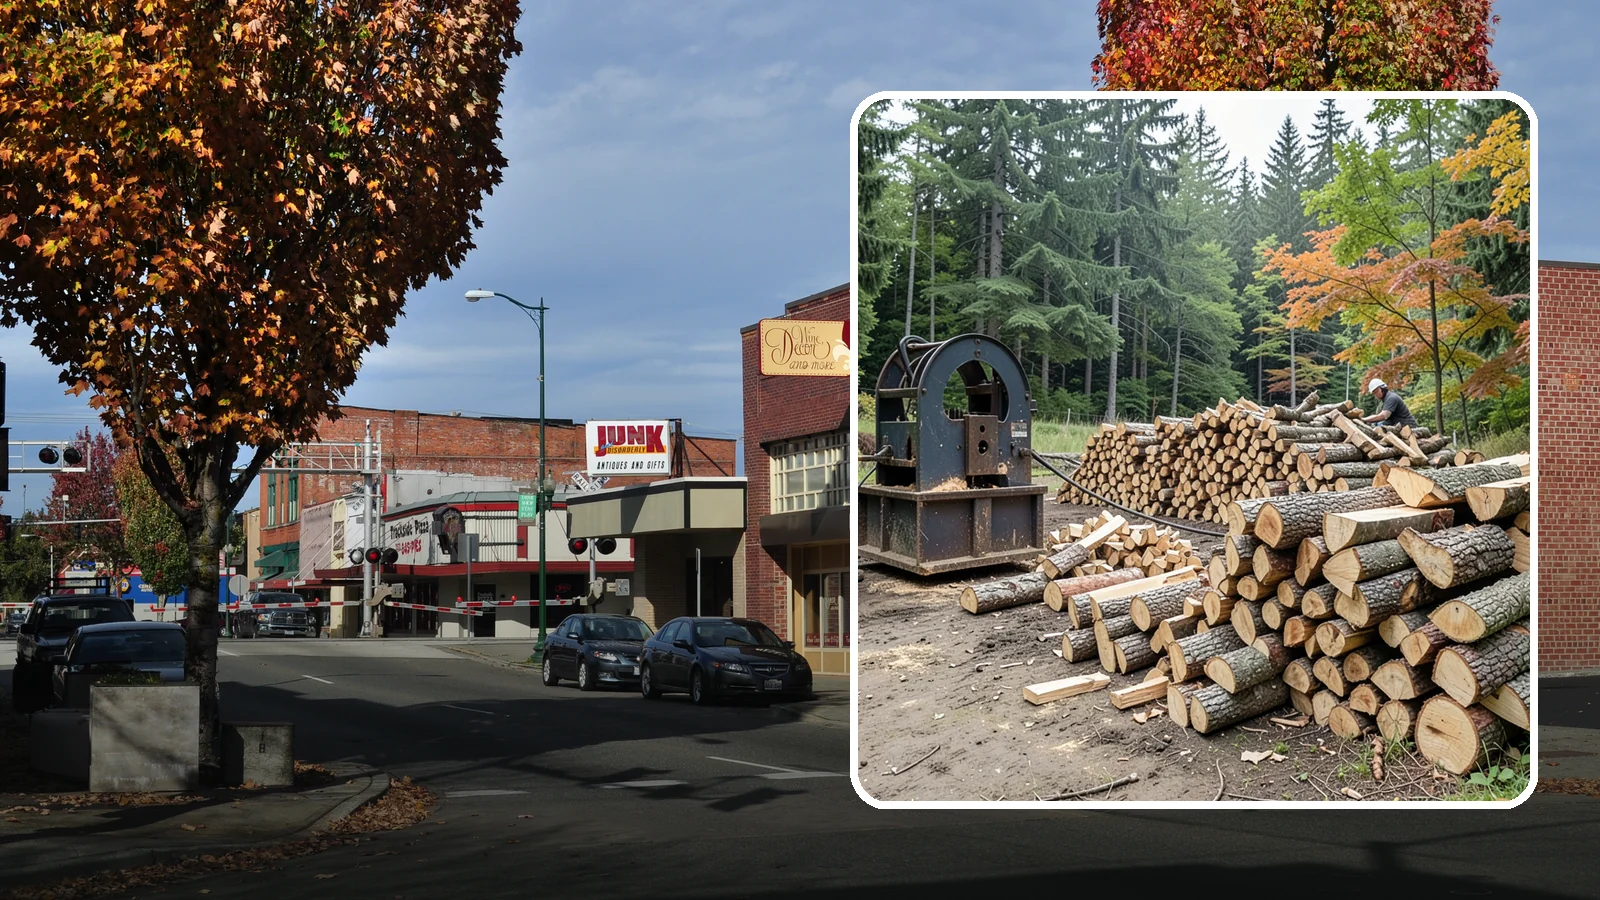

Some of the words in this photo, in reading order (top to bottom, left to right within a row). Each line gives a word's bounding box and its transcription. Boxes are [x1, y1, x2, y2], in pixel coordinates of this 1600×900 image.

[595, 425, 665, 457] JUNK
[607, 446, 646, 454] DISORDERLY
[597, 461, 628, 470] ANTIQUES
[631, 461, 644, 470] AND
[647, 460, 665, 469] GIFTS
